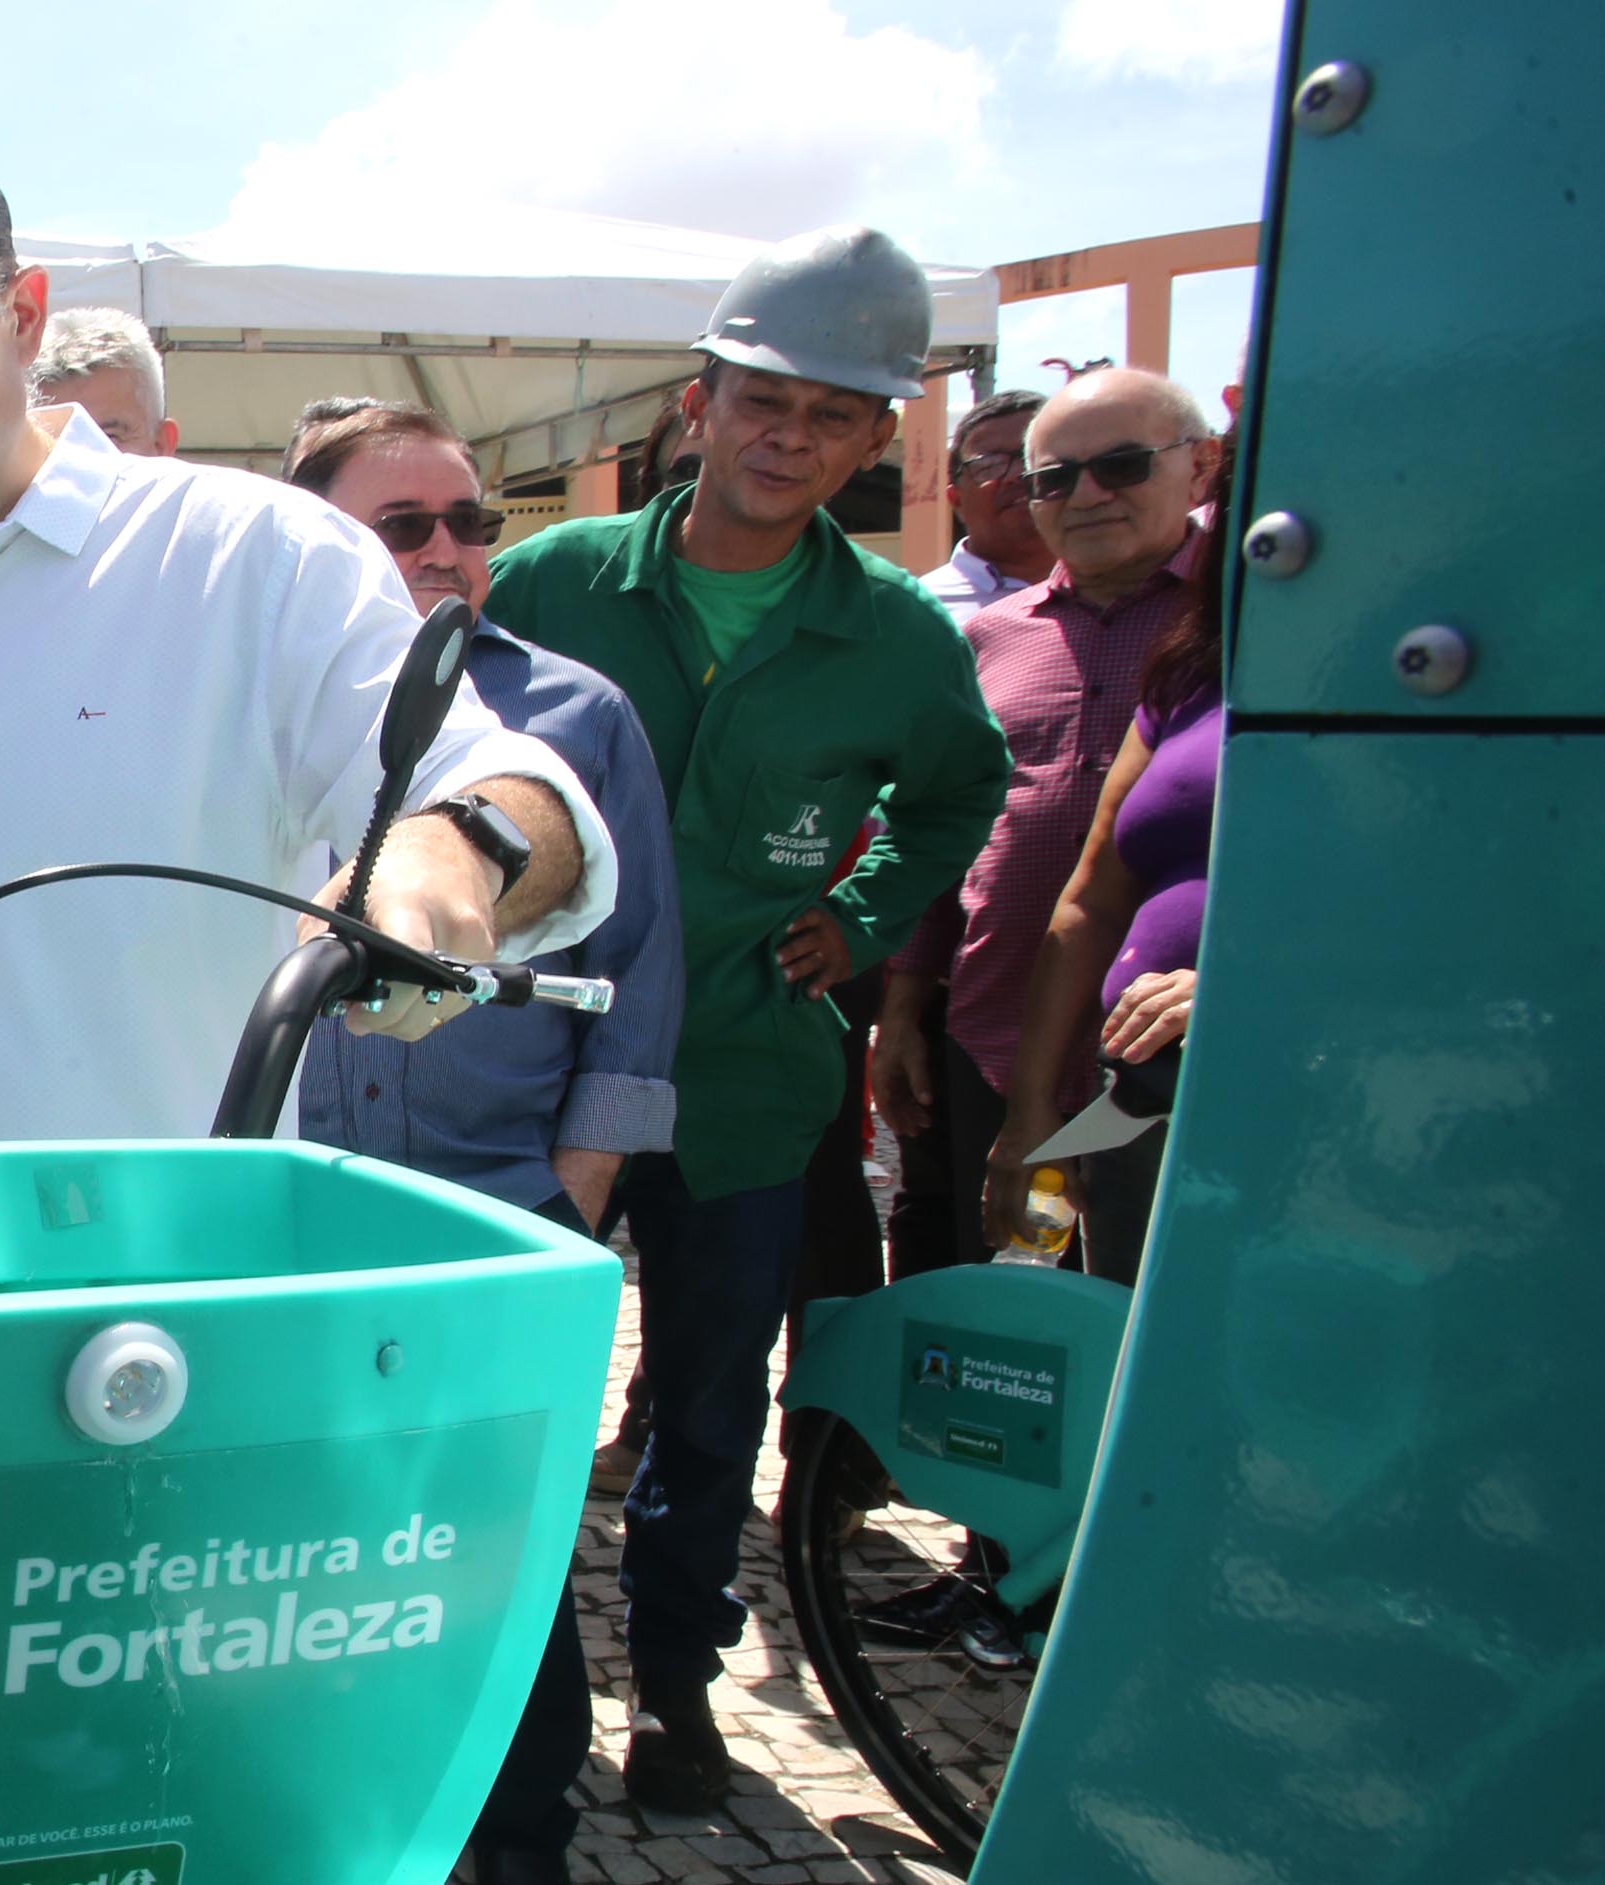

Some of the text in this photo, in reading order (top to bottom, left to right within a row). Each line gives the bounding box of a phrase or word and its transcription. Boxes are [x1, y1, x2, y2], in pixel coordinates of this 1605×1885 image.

[961, 1371, 1053, 1404] Fortaleza
[962, 1357, 1055, 1385] Prefeitura de
[13, 1513, 456, 1607] Prefeitura de
[4, 1591, 444, 1696] Fortaleza
[18, 1834, 37, 1846] DE
[83, 1824, 116, 1838] ESSE
[119, 1820, 129, 1834] É
[130, 1820, 141, 1833] O
[143, 1814, 194, 1831] PLANO.
